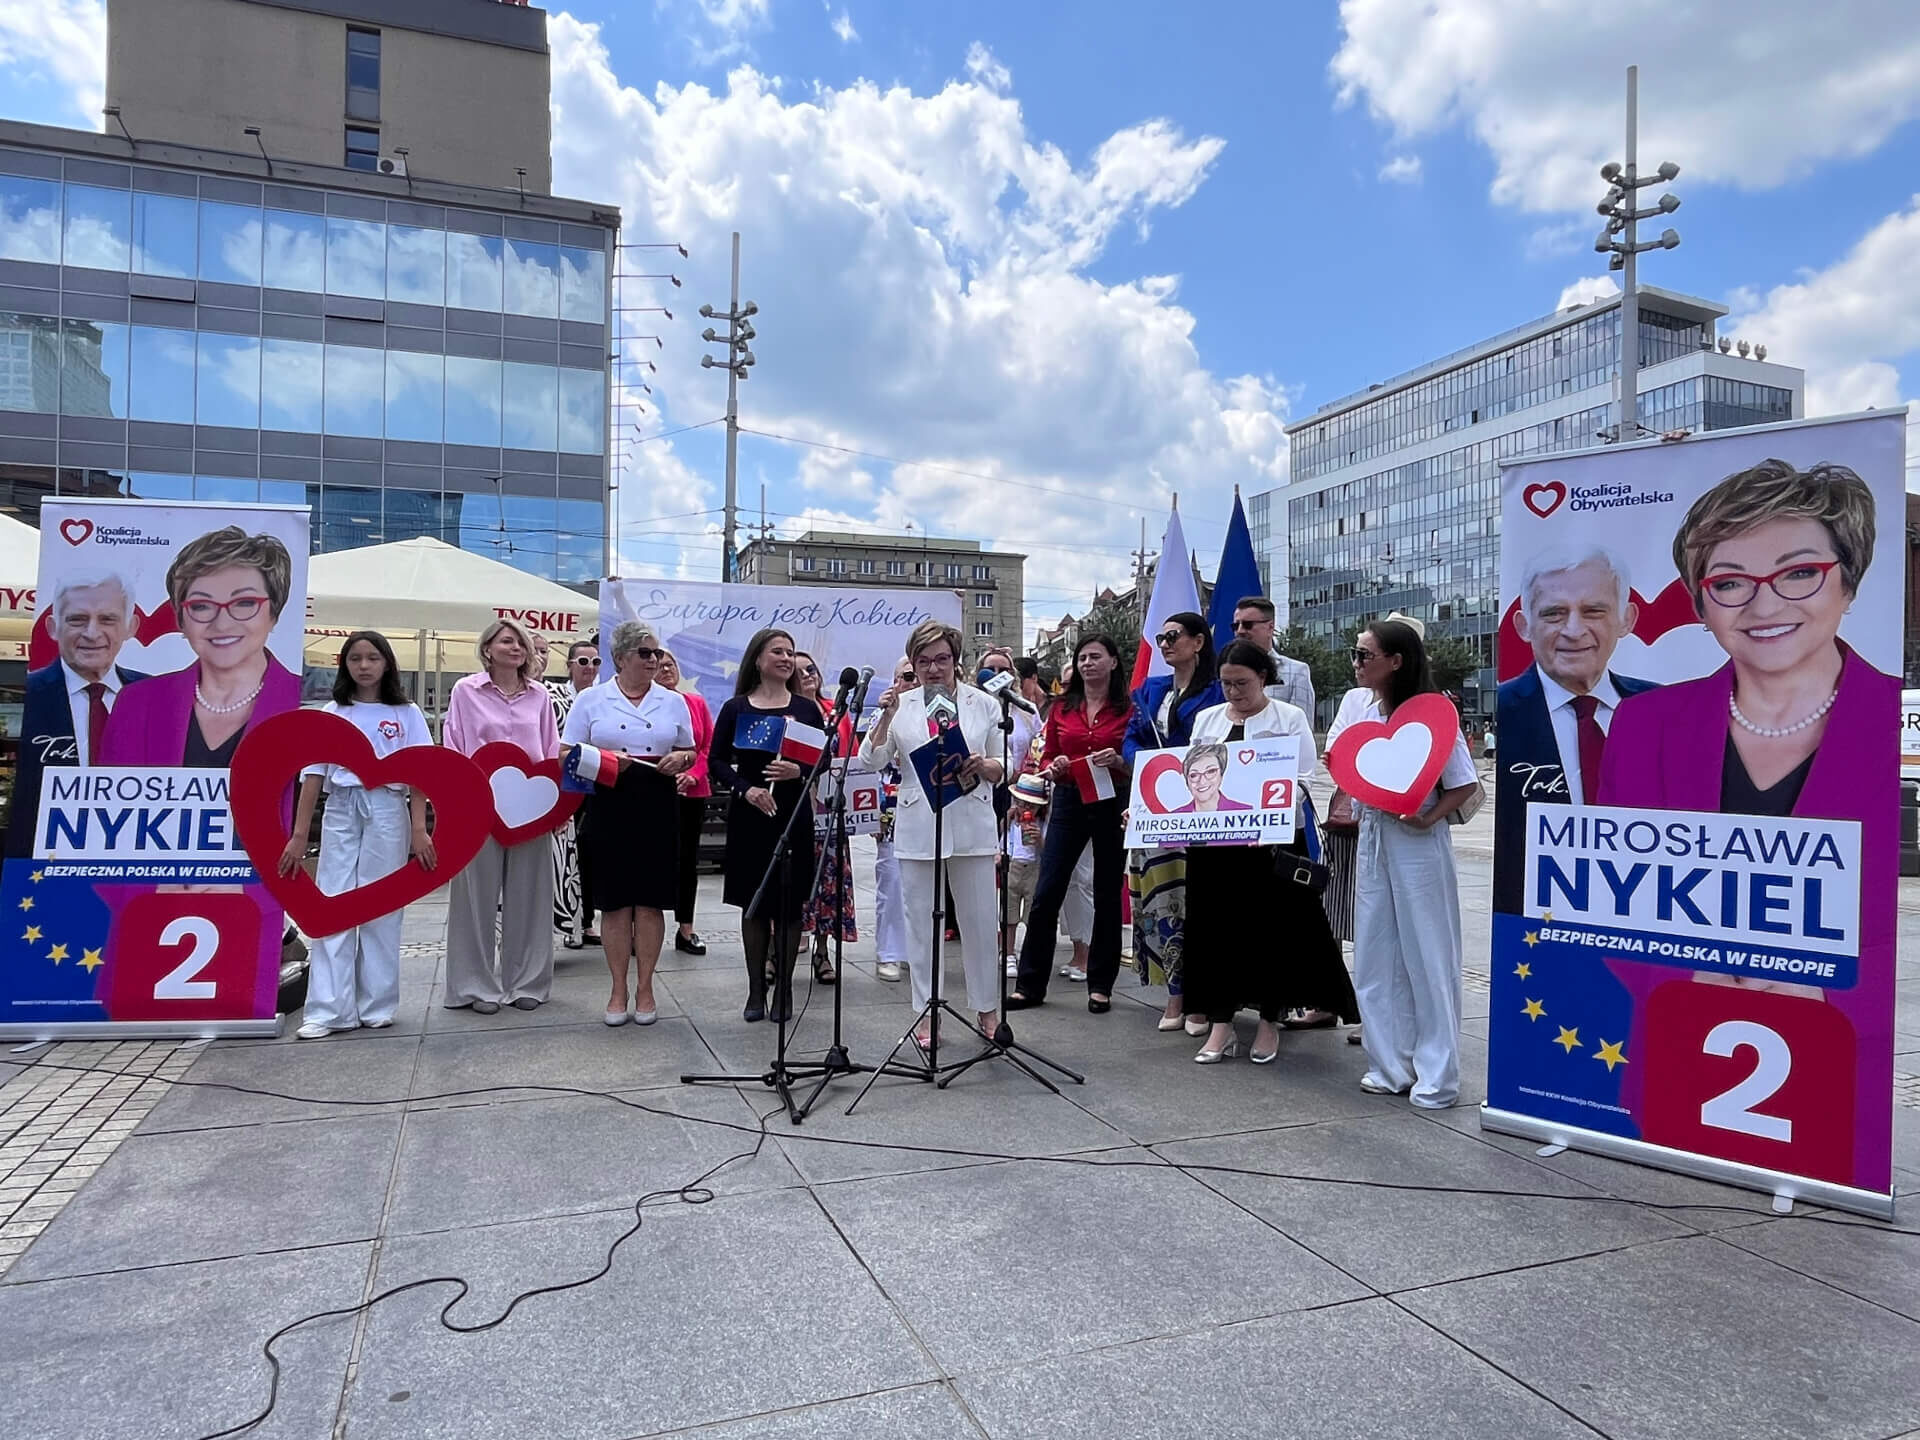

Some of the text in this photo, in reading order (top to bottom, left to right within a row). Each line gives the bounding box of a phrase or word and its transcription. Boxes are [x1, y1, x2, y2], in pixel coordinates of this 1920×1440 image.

[1570, 482, 1632, 499] Koalicja
[1570, 491, 1674, 512] Obywatelska
[95, 535, 170, 546] Obywatelska
[96, 526, 142, 537] Koalicja
[492, 608, 580, 632] TYSKIE
[638, 589, 763, 634] Europa
[764, 603, 820, 632] jest
[51, 776, 230, 802] MIROSŁAW
[858, 791, 872, 808] 2
[1267, 783, 1286, 805] 2
[1135, 813, 1290, 832] MIROSŁAWA NYKIEL
[1538, 814, 1845, 870] MIROSŁAWA
[44, 866, 252, 877] BEZPIECZNA POLSKA W EUROPIE
[1536, 855, 1845, 941] NYKIEL
[154, 916, 220, 1000] 2
[1540, 928, 1836, 978] BEZPIECZNA POLSKA W EUROPIE
[1701, 1019, 1792, 1143] 2
